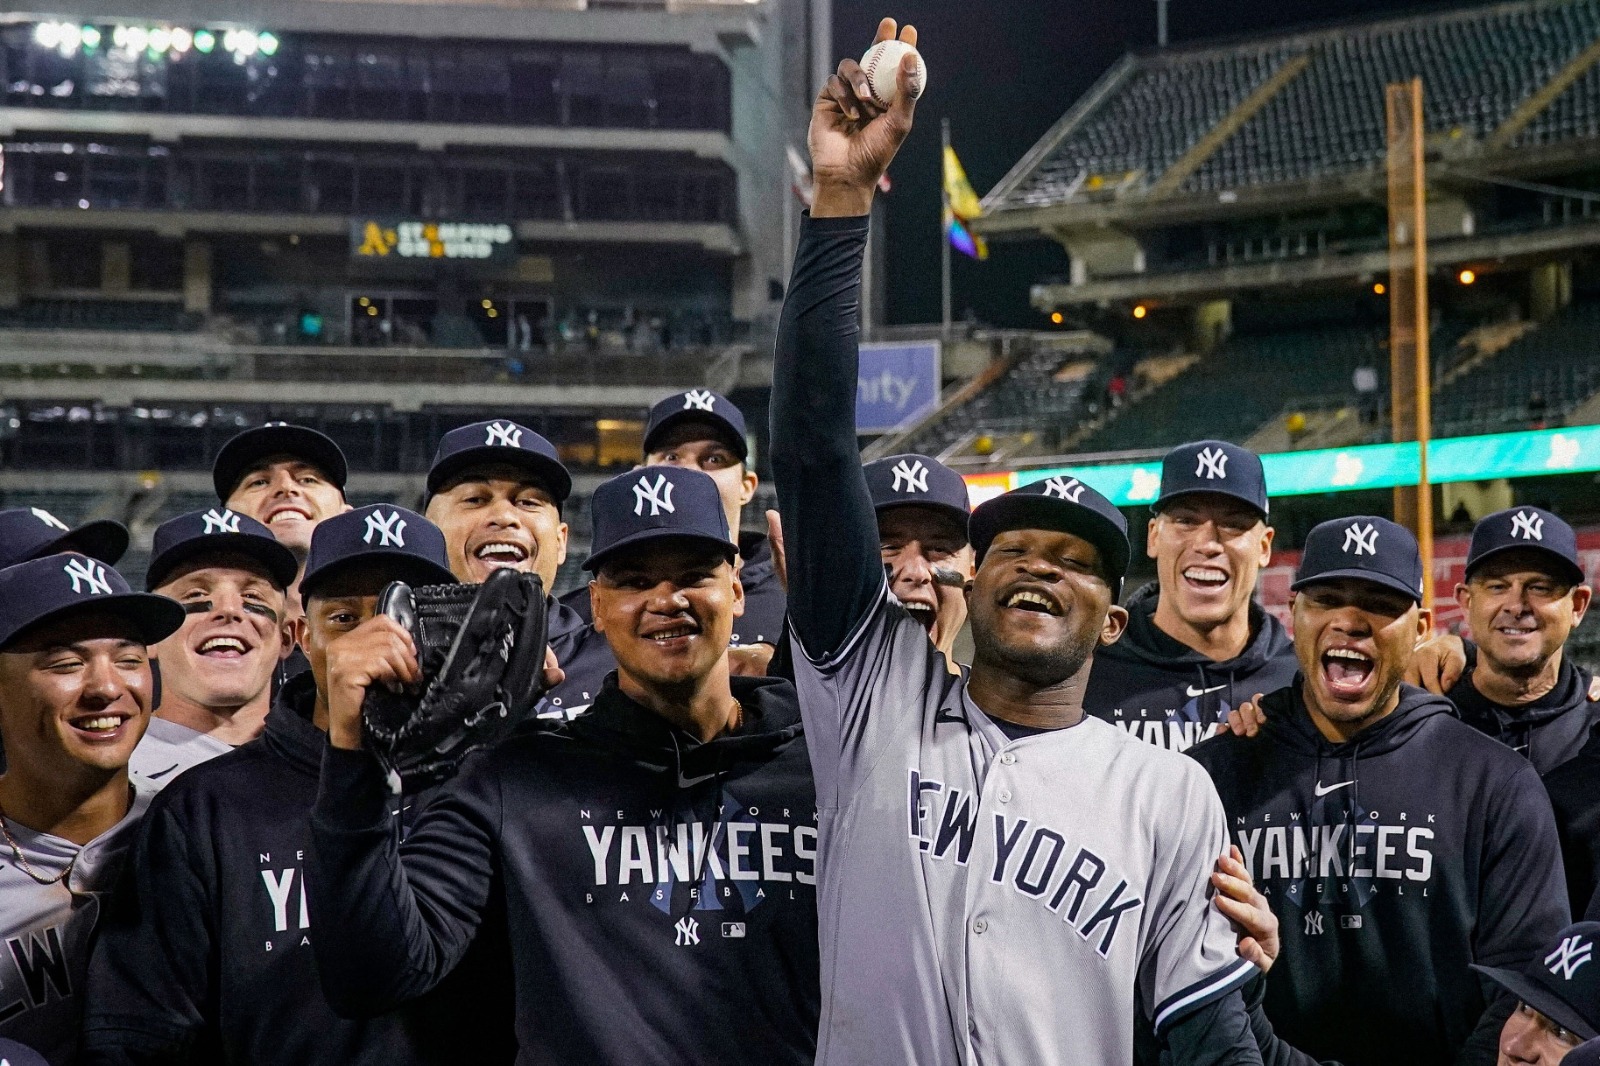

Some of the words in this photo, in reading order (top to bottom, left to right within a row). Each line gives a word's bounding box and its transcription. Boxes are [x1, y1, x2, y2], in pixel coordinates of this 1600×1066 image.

[683, 389, 715, 412] NY
[485, 421, 523, 448] NY
[891, 459, 929, 494] NY
[1195, 446, 1229, 480] NY
[632, 473, 675, 516] NY
[202, 508, 241, 534] NY
[363, 508, 408, 548] NY
[1510, 510, 1545, 542] NY
[1342, 522, 1380, 556] NY
[64, 557, 113, 594] NY
[1114, 708, 1176, 717] NEW
[580, 809, 663, 820] NEW
[1237, 812, 1301, 825] NEW
[1343, 810, 1436, 823] YORK
[582, 821, 818, 886] YANKEES
[1238, 824, 1435, 882] YANKEES
[990, 811, 1145, 960] YORK
[674, 916, 701, 946] NY
